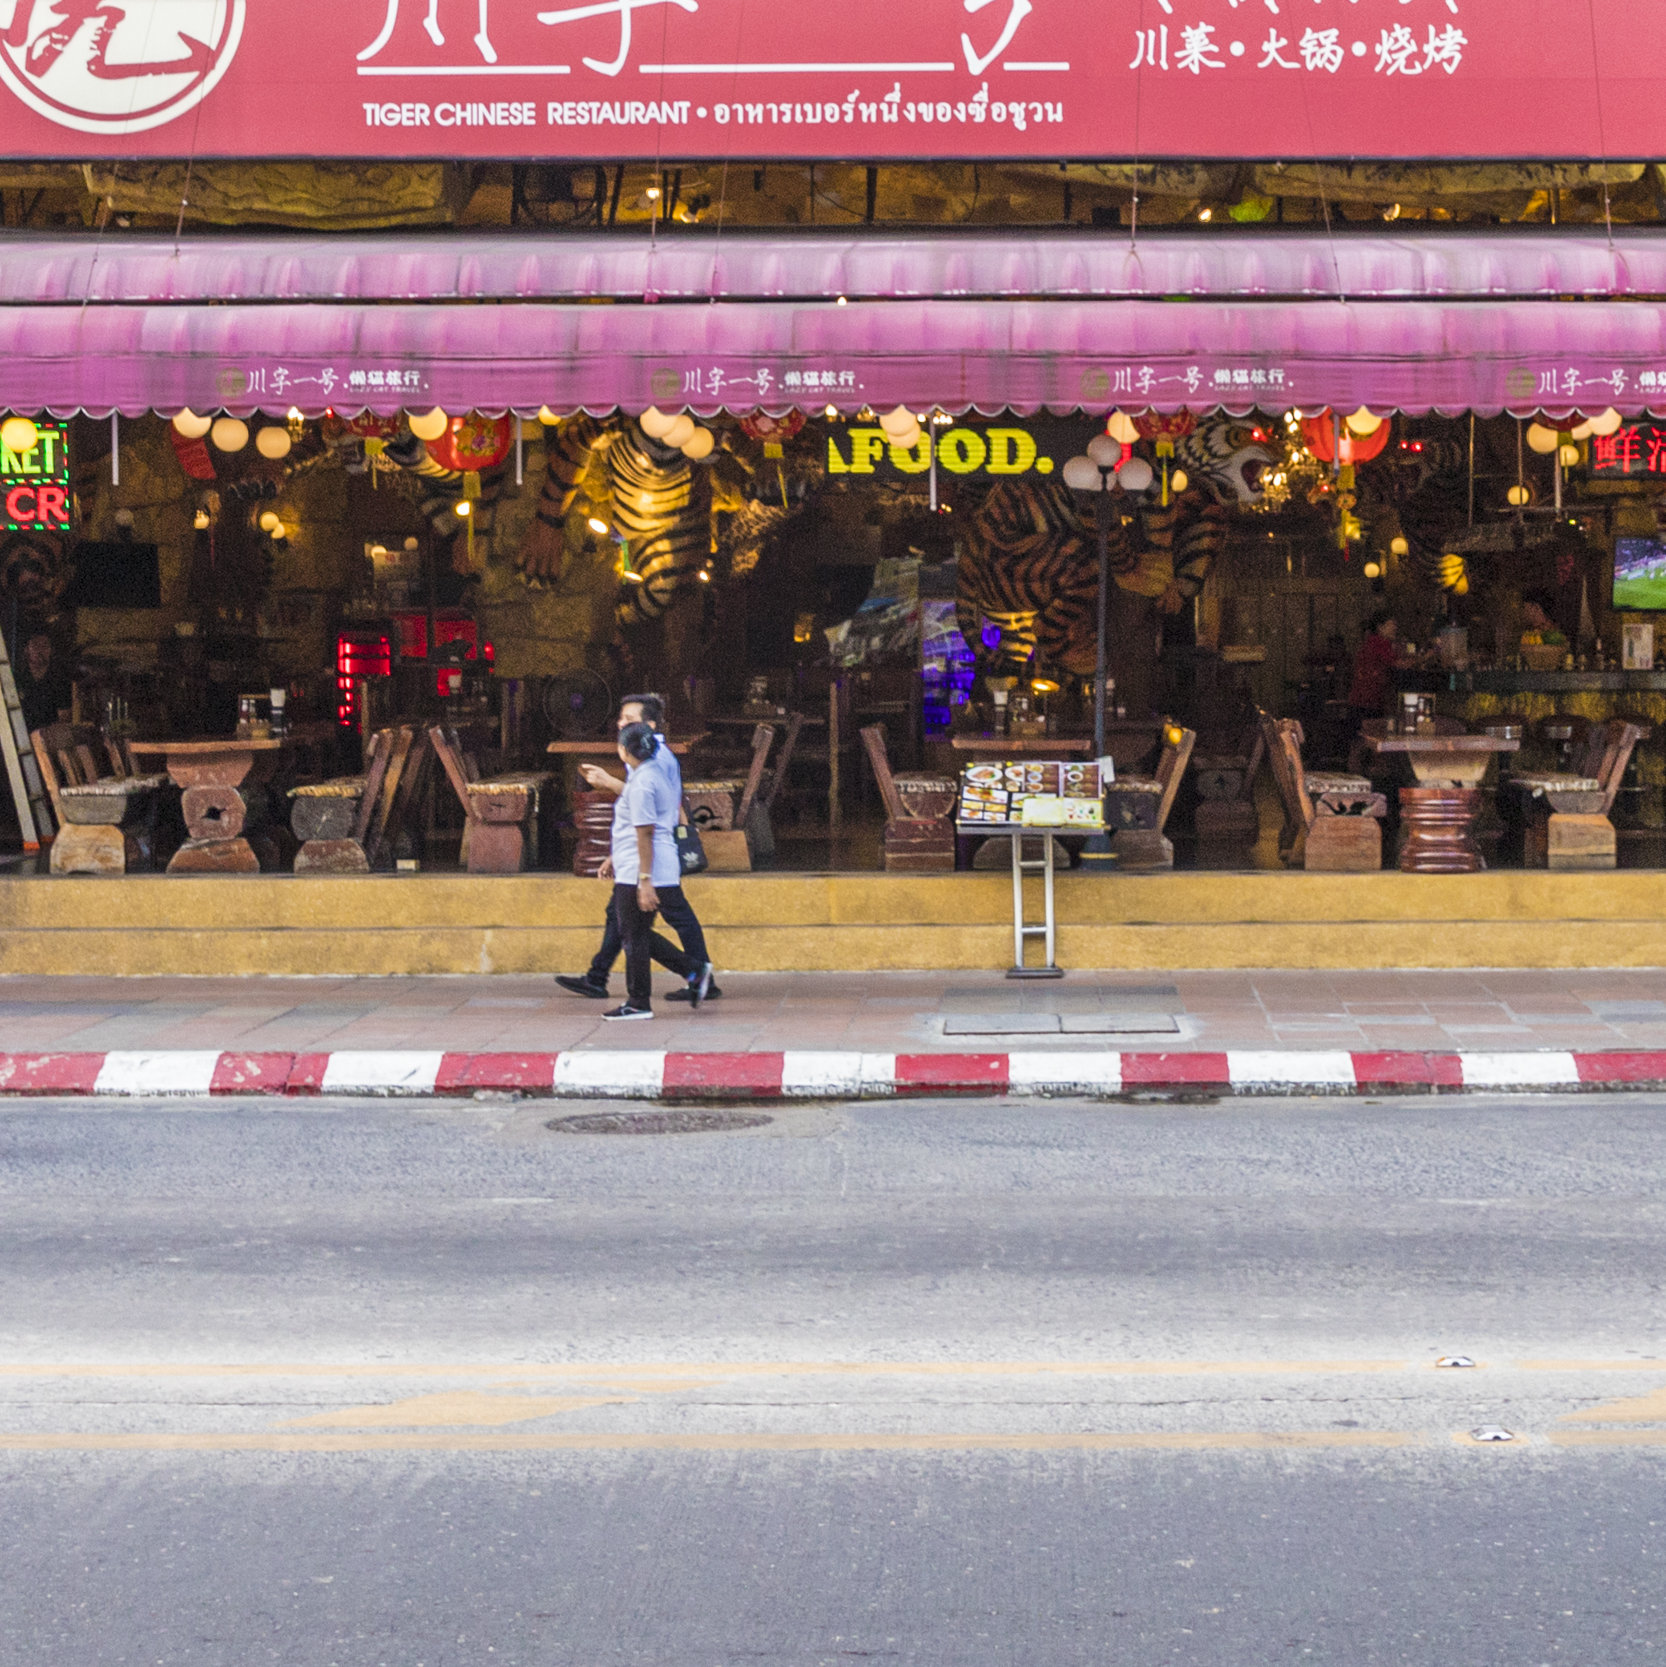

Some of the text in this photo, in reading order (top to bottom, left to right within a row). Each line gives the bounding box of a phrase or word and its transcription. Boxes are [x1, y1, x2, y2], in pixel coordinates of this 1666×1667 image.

[363, 101, 690, 127] TIGER CHINESE RESTAURANT
[247, 367, 339, 395] 川字一号
[683, 367, 774, 395] 川字一号
[1113, 366, 1204, 394] 川字一号
[1539, 368, 1629, 396] 川字一号
[6, 487, 70, 523] CR
